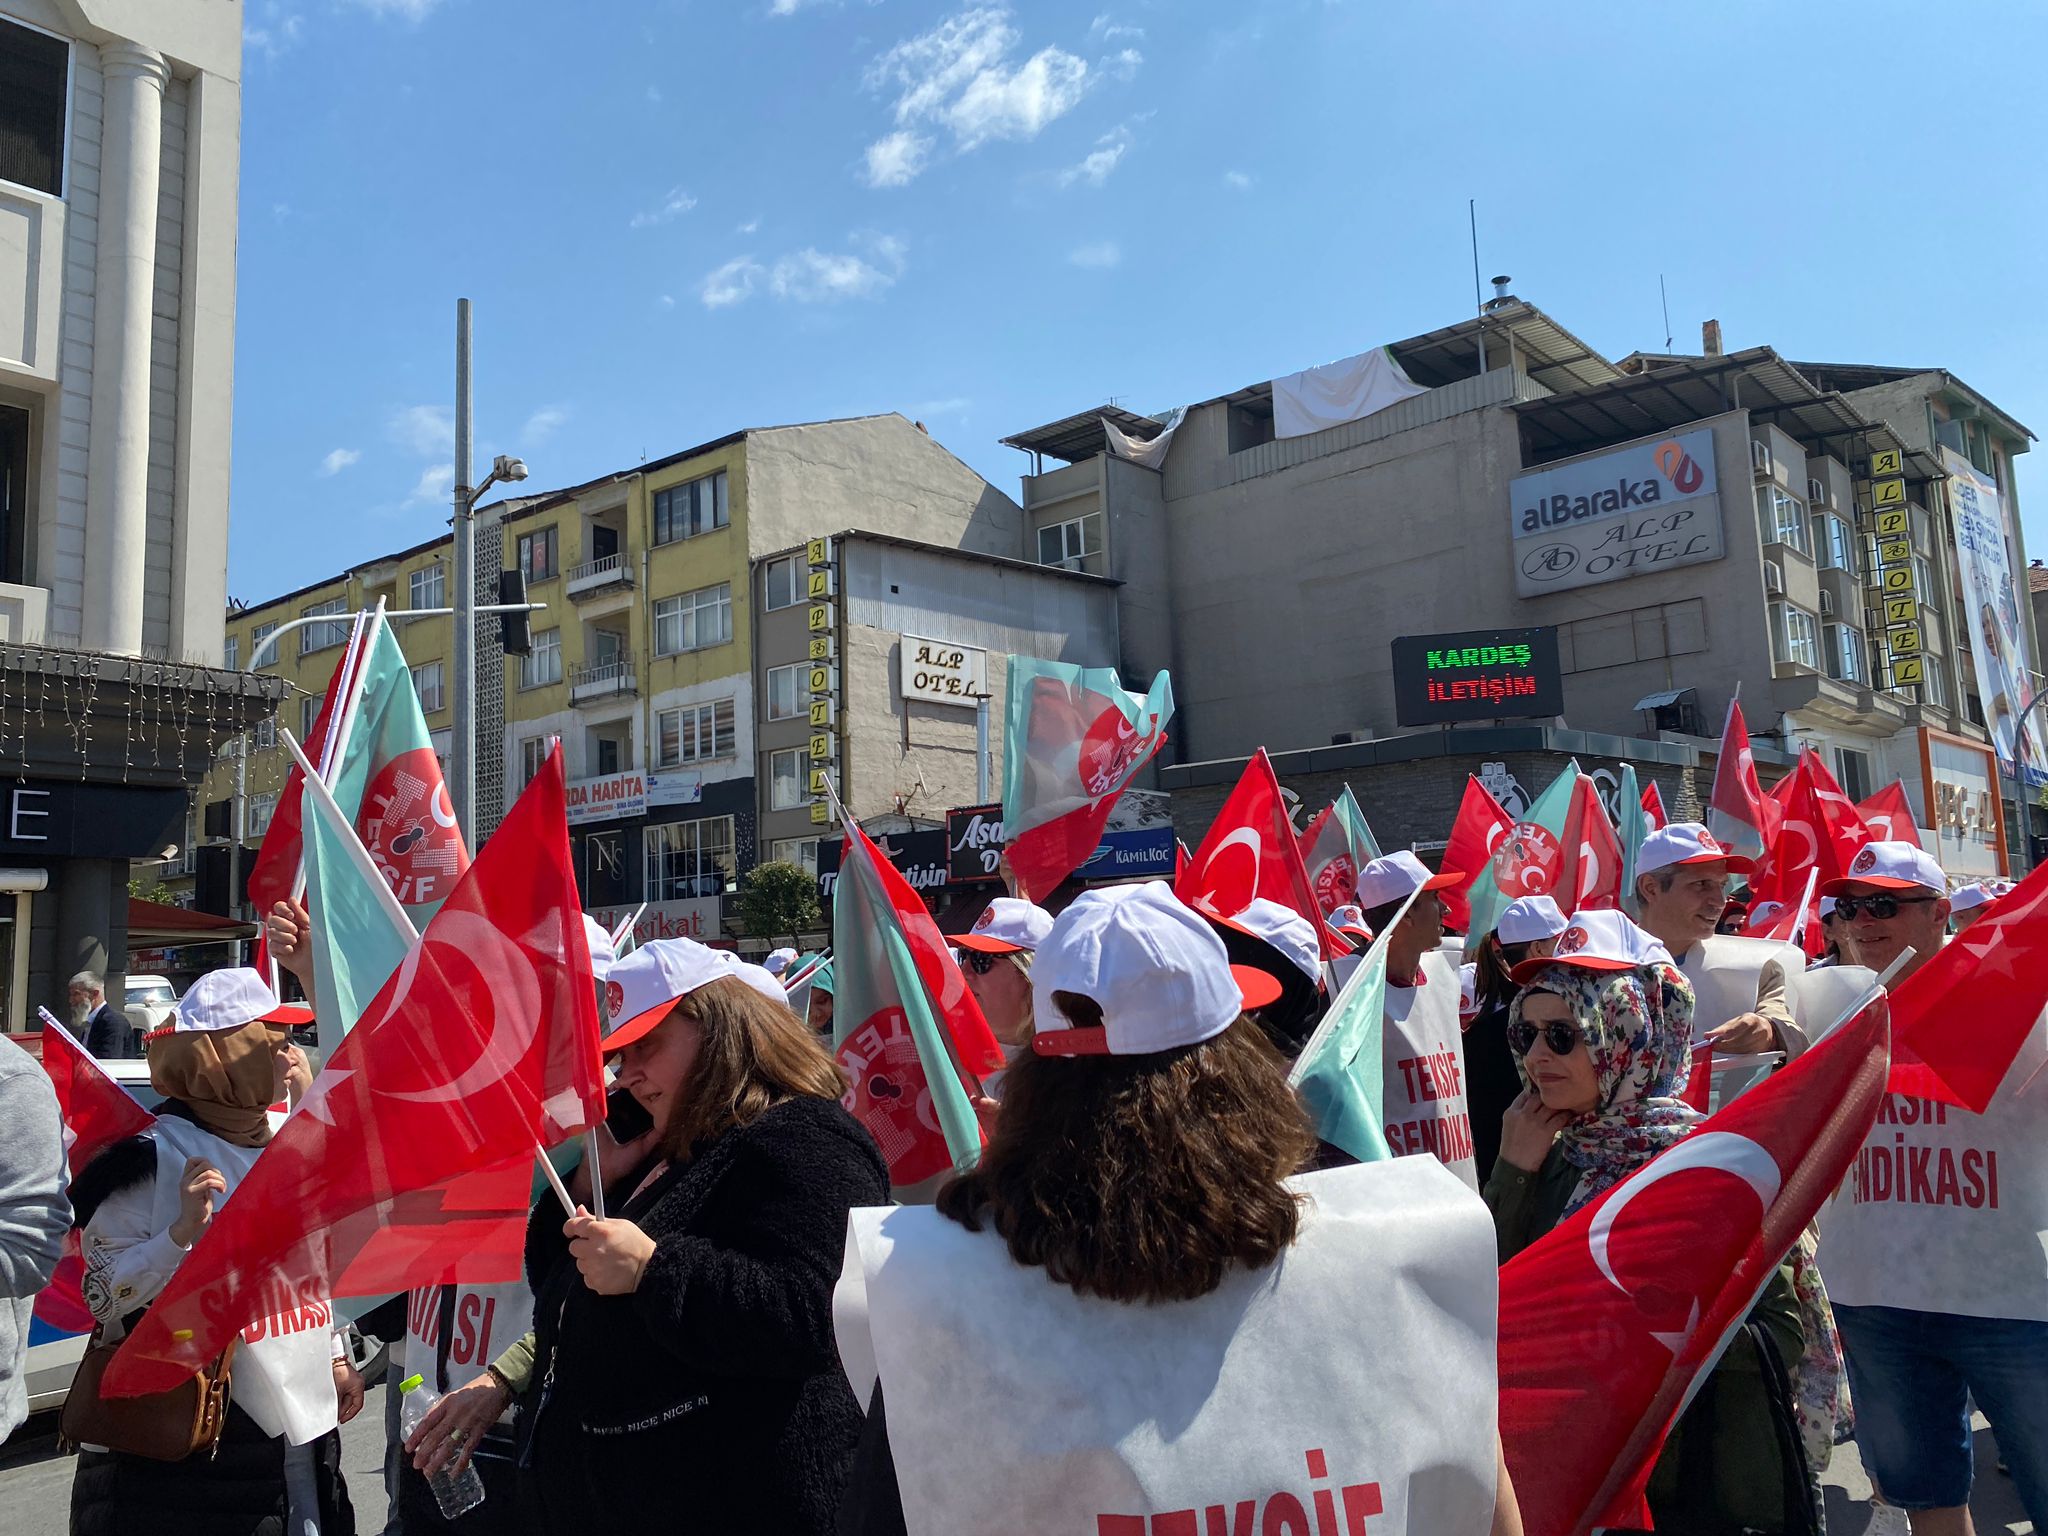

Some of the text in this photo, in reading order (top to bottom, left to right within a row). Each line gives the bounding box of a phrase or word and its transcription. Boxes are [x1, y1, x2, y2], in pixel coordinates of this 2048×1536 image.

[1521, 478, 1661, 533] alBaraka
[1592, 510, 1695, 551] ALP
[1585, 534, 1711, 575] OTEL
[914, 646, 965, 669] ALP
[1426, 644, 1532, 669] KARDEŞ
[913, 672, 978, 698] OTEL
[1427, 673, 1537, 704] İLETİŞİM
[591, 774, 643, 803] HARİTA
[597, 911, 704, 940] Hkikat
[663, 1400, 693, 1421] NICE
